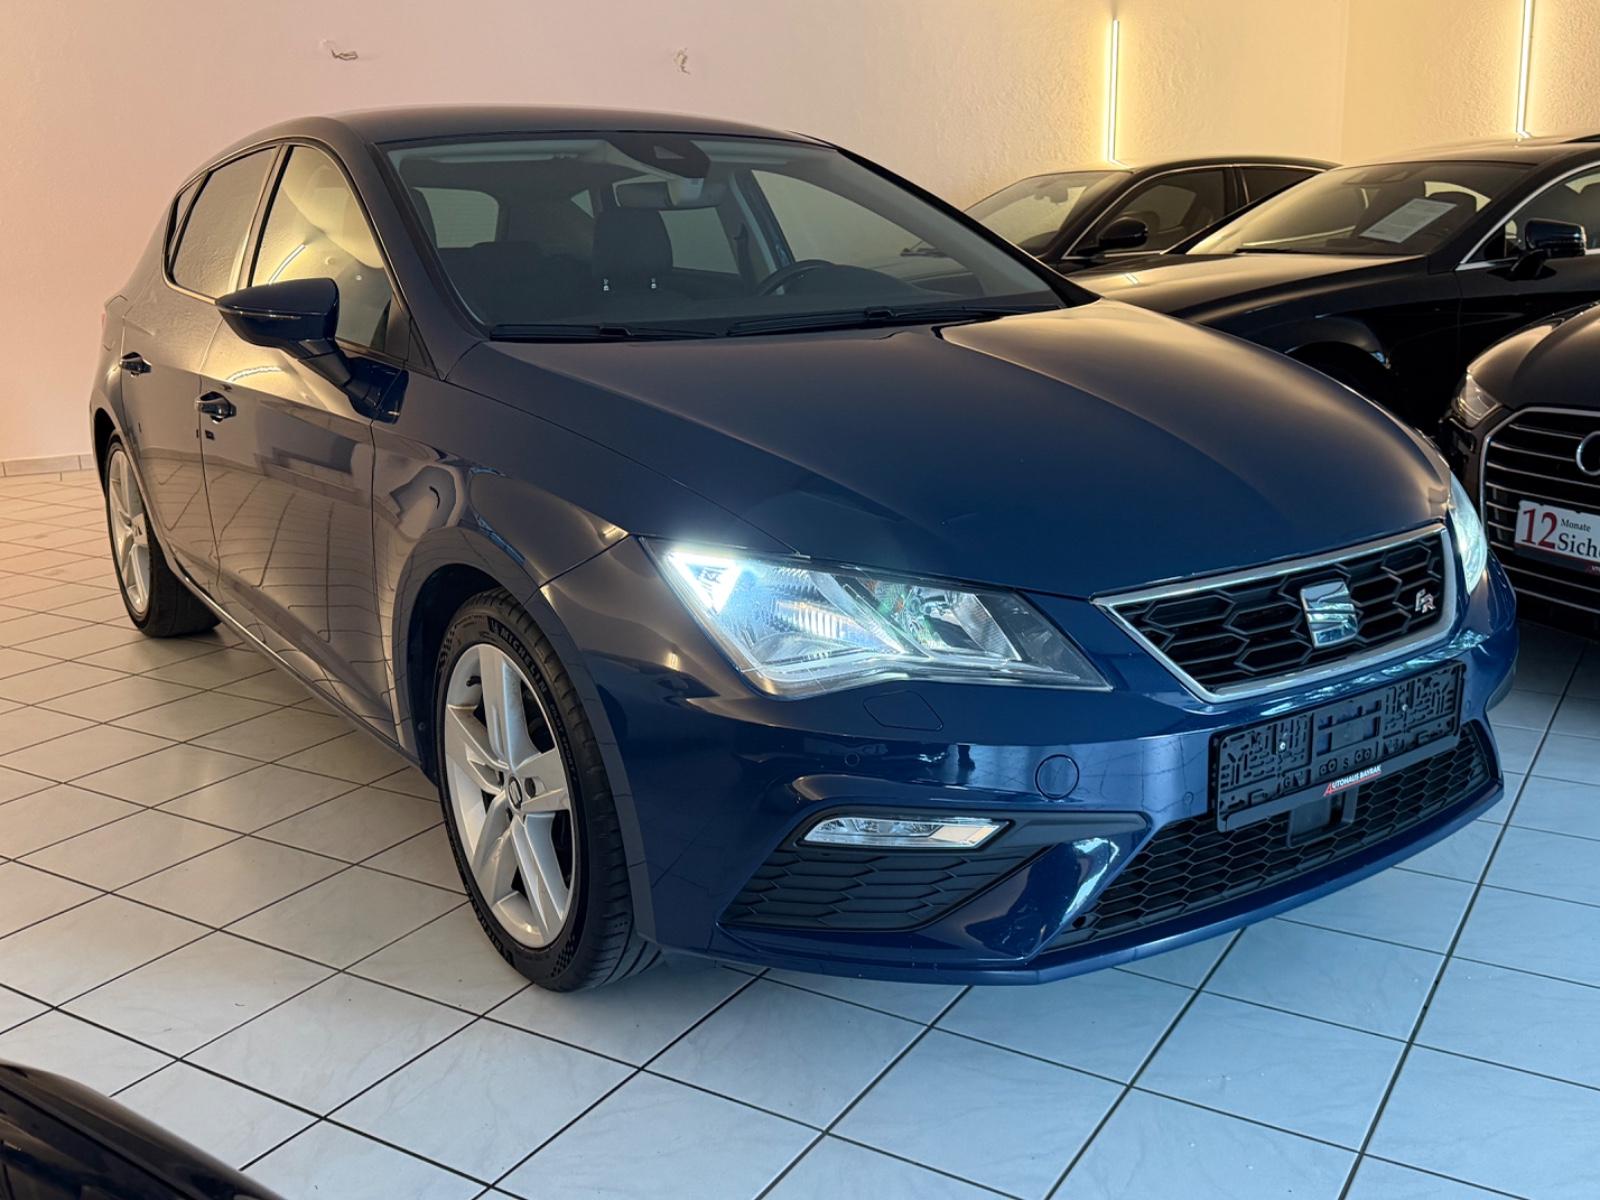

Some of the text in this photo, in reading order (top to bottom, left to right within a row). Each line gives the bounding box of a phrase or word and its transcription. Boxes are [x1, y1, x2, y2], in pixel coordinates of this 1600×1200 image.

[1521, 508, 1558, 549] 12
[1560, 518, 1592, 532] Monate
[1557, 532, 1600, 558] Sich
[500, 628, 547, 694] MICHELIN
[1323, 771, 1361, 797] AUTOHAUS
